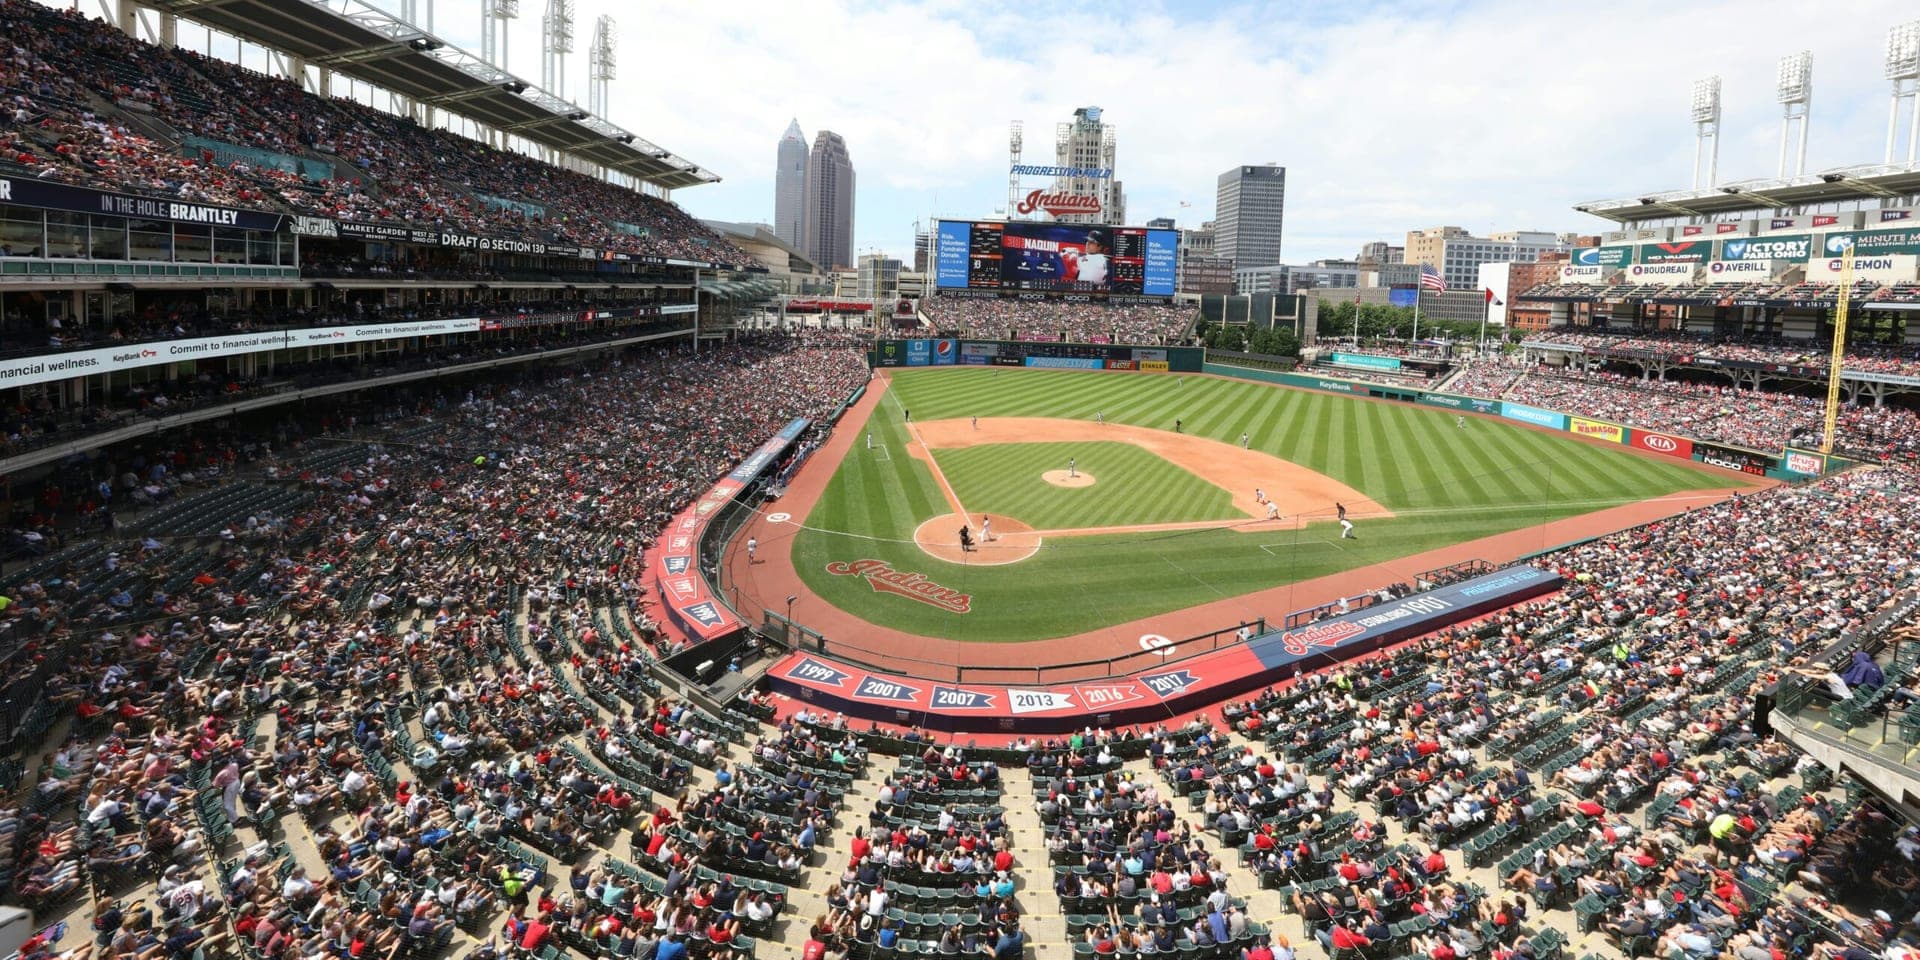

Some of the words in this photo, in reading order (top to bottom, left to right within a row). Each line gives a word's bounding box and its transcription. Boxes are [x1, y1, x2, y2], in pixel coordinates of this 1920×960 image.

[1010, 164, 1079, 177] PROGRESSIVE
[1080, 168, 1112, 179] FIELD
[1017, 188, 1101, 217] Indians
[101, 195, 114, 212] IN
[115, 197, 135, 215] THE
[137, 200, 168, 217] HOLE:
[169, 203, 238, 225] BRANTLEY
[342, 224, 375, 233] MARKET
[376, 227, 407, 237] GARDEN
[442, 234, 478, 248] DRAFT
[479, 238, 490, 250] @
[492, 239, 530, 253] SECTION
[532, 243, 545, 255] 130
[1024, 238, 1059, 252] NAQUIN
[1858, 234, 1906, 243] MINUTE
[1743, 251, 1773, 260] PARK
[1774, 250, 1807, 258] OHIO
[1573, 267, 1598, 275] FELLER
[1644, 265, 1688, 274] BOUDREAU
[1725, 262, 1766, 272] AVERILL
[1852, 259, 1892, 270] EMON
[308, 333, 332, 341] KeyBank
[355, 328, 383, 337] Commit
[170, 341, 208, 355] Commit
[210, 339, 220, 350] to
[222, 336, 259, 349] financial
[261, 334, 299, 346] wellness.
[113, 352, 141, 363] KeyBank
[1031, 358, 1097, 369] PROGRESSIVE
[48, 358, 100, 372] wellness.
[1319, 381, 1351, 392] KeyBank
[1649, 436, 1671, 448] KIA
[1704, 456, 1742, 471] NOCO
[1789, 453, 1816, 469] drug
[826, 558, 972, 614] Indians
[1281, 618, 1368, 656] Indians
[1402, 595, 1454, 616] 1901
[798, 662, 835, 681] 1999
[863, 680, 902, 698] 2001
[1149, 673, 1183, 692] 2017
[938, 691, 975, 706] 2007
[1016, 694, 1054, 707] 2013
[1087, 687, 1124, 702] 2016
